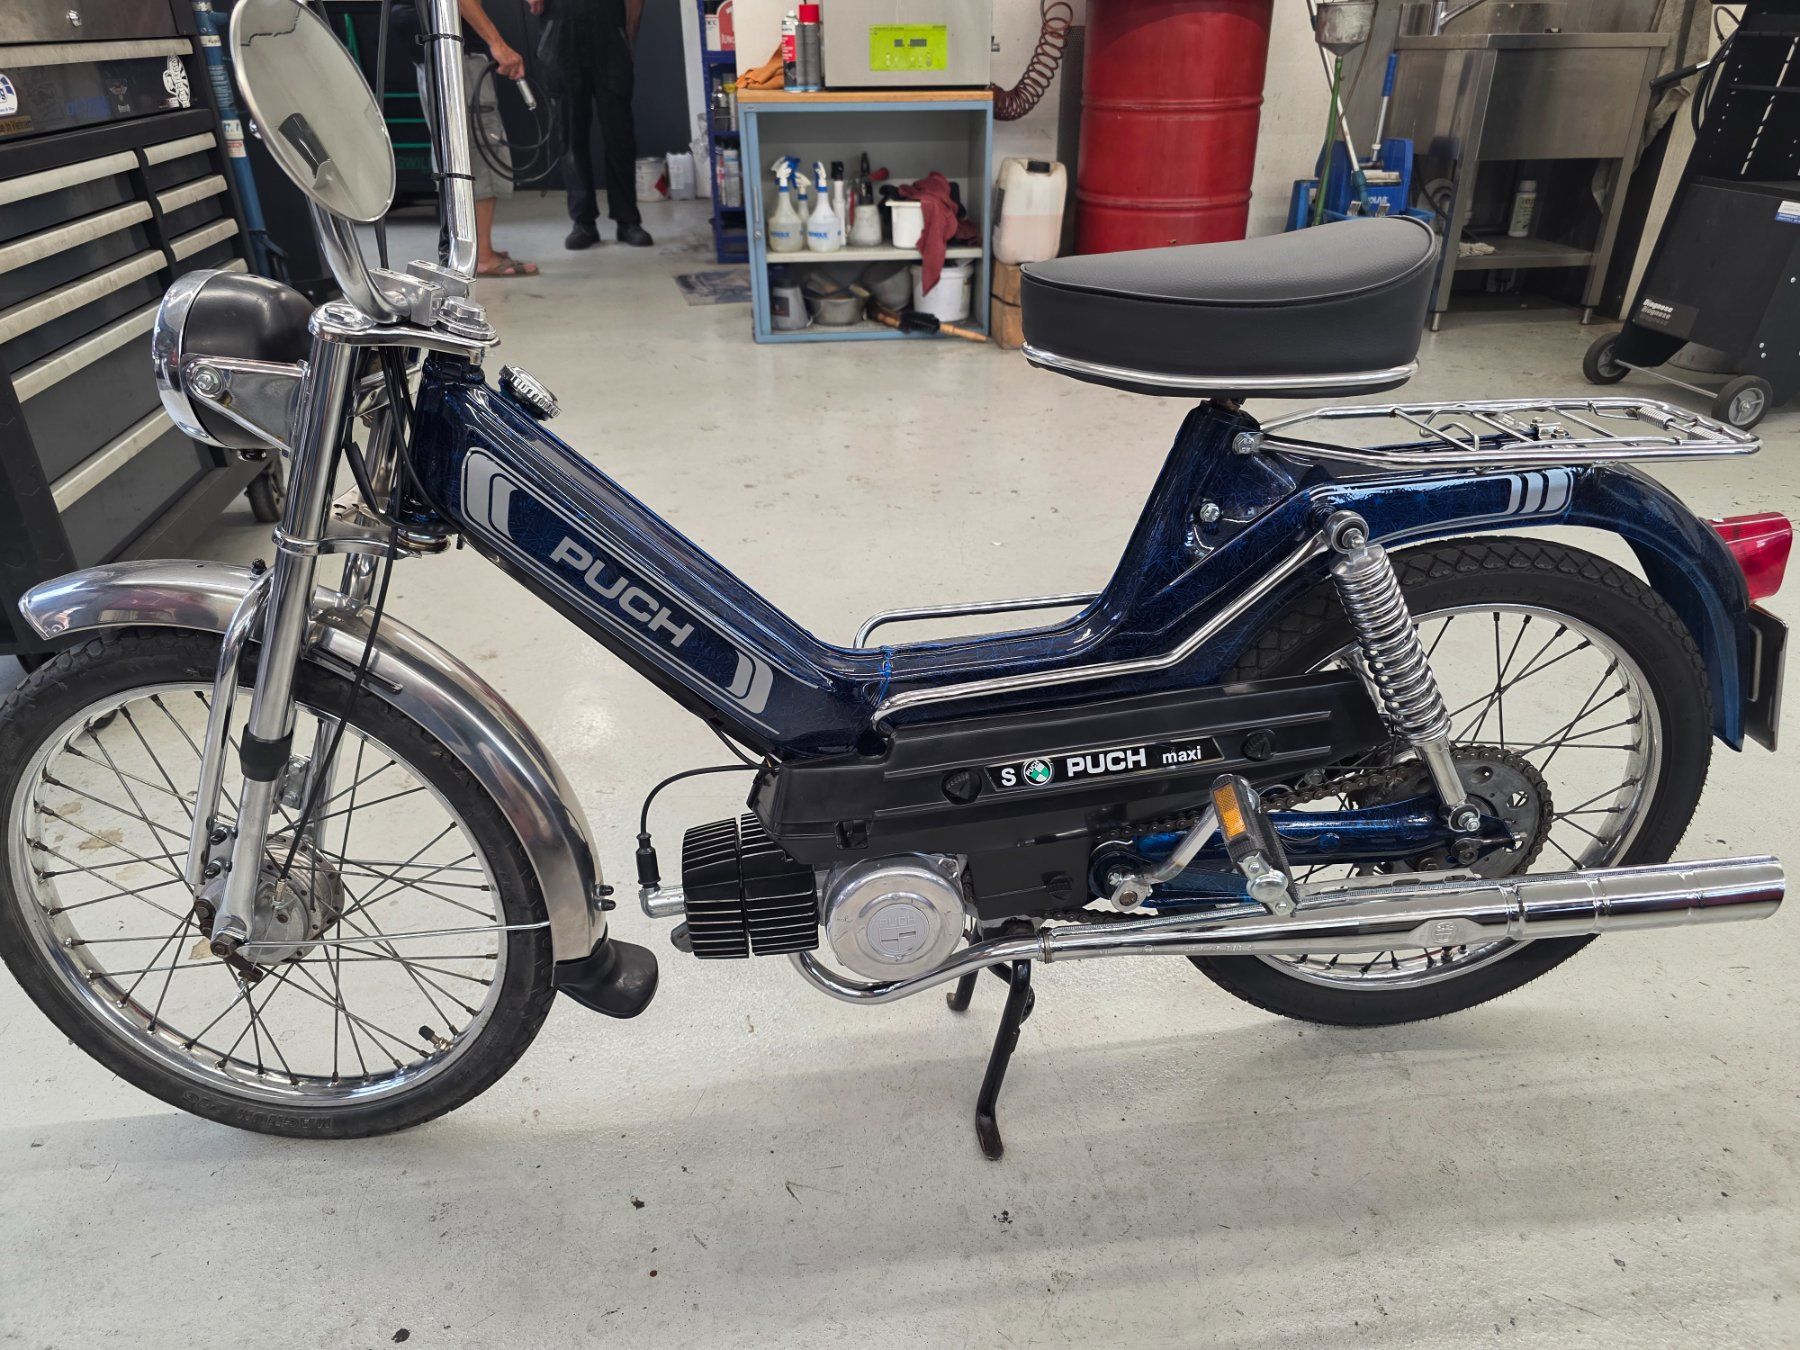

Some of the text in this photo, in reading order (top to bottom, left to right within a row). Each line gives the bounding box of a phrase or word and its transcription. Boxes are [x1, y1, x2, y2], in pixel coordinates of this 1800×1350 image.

[1643, 299, 1673, 312] Diagnose
[550, 536, 695, 647] PUCH
[1001, 746, 1202, 786] S PUCH maxi
[1026, 760, 1041, 776] PUCH
